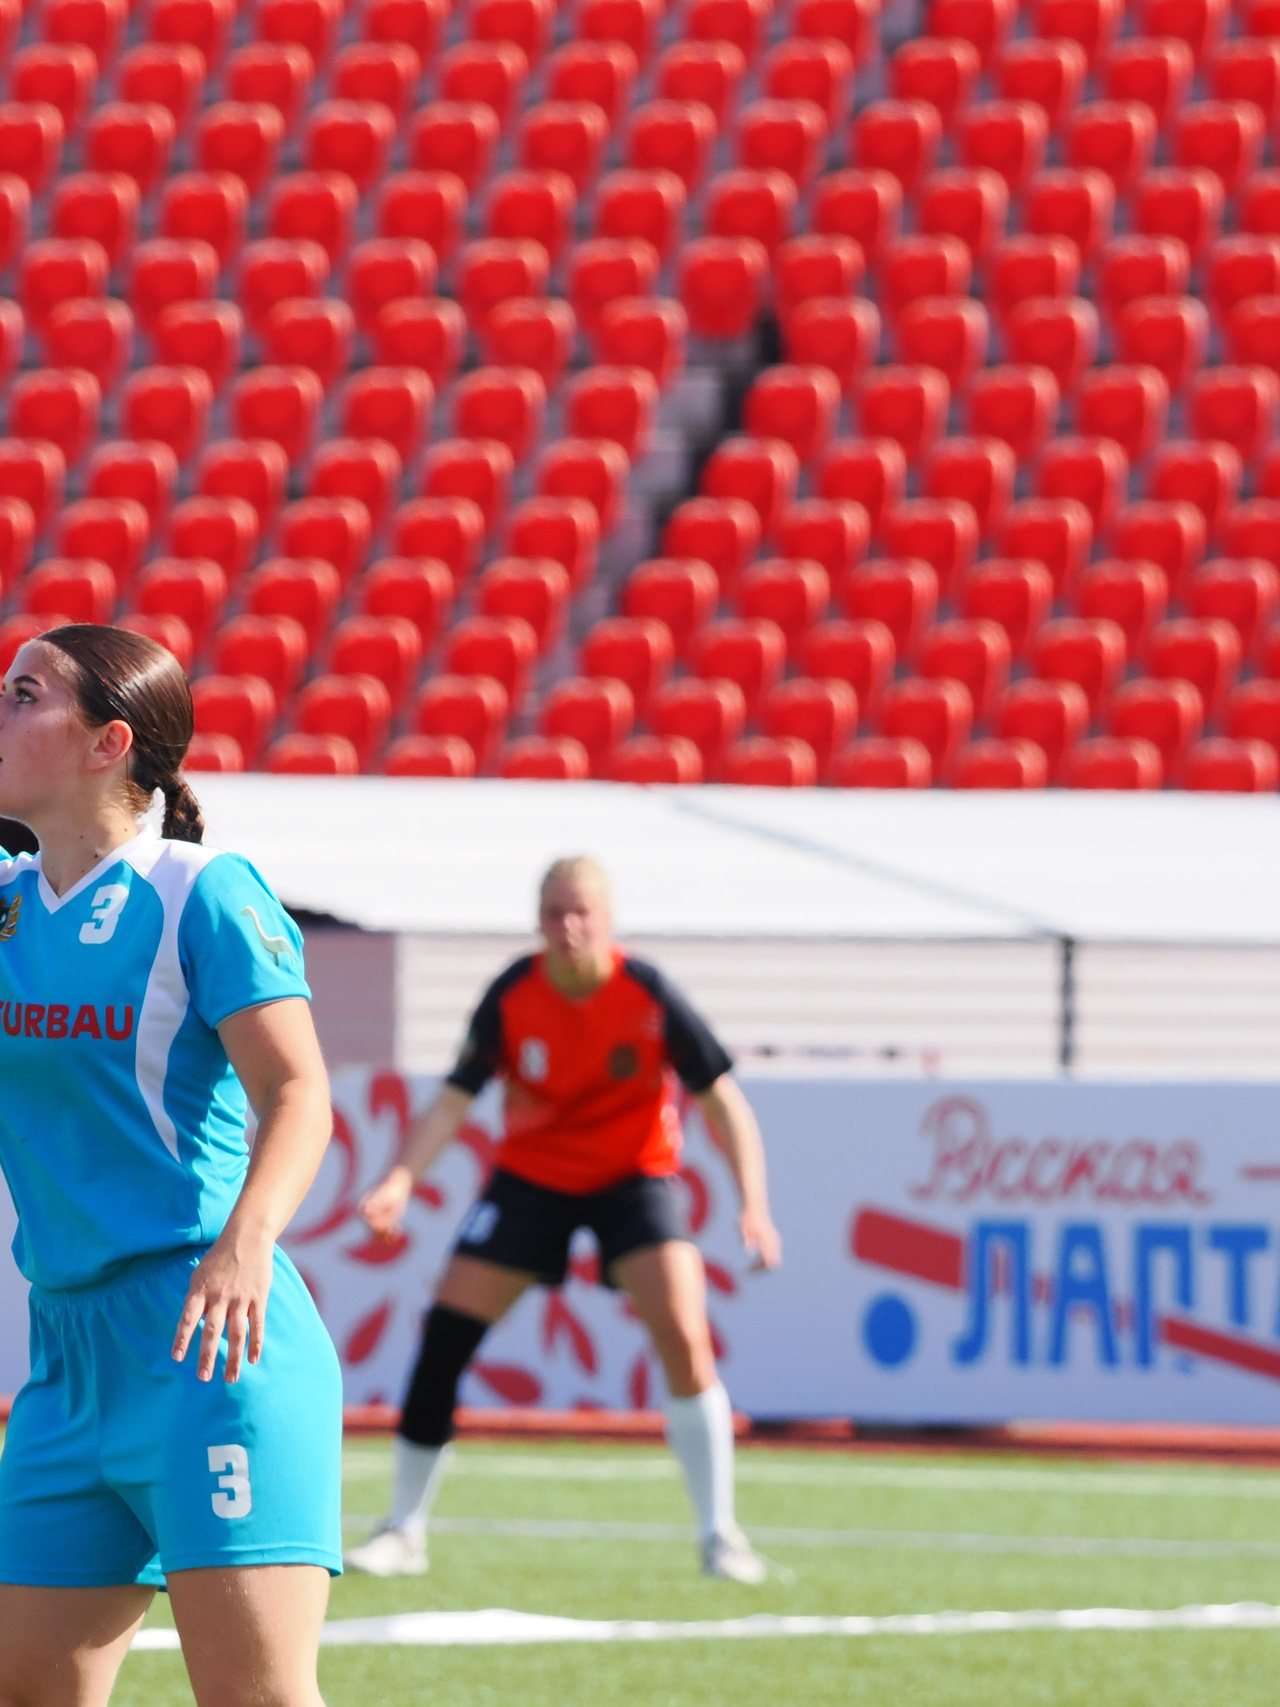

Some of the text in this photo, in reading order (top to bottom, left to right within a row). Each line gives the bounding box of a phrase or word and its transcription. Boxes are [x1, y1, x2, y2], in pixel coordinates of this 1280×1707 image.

[78, 884, 130, 945] 3
[954, 1221, 1280, 1376] ЛАПТ
[207, 1444, 252, 1519] 3
